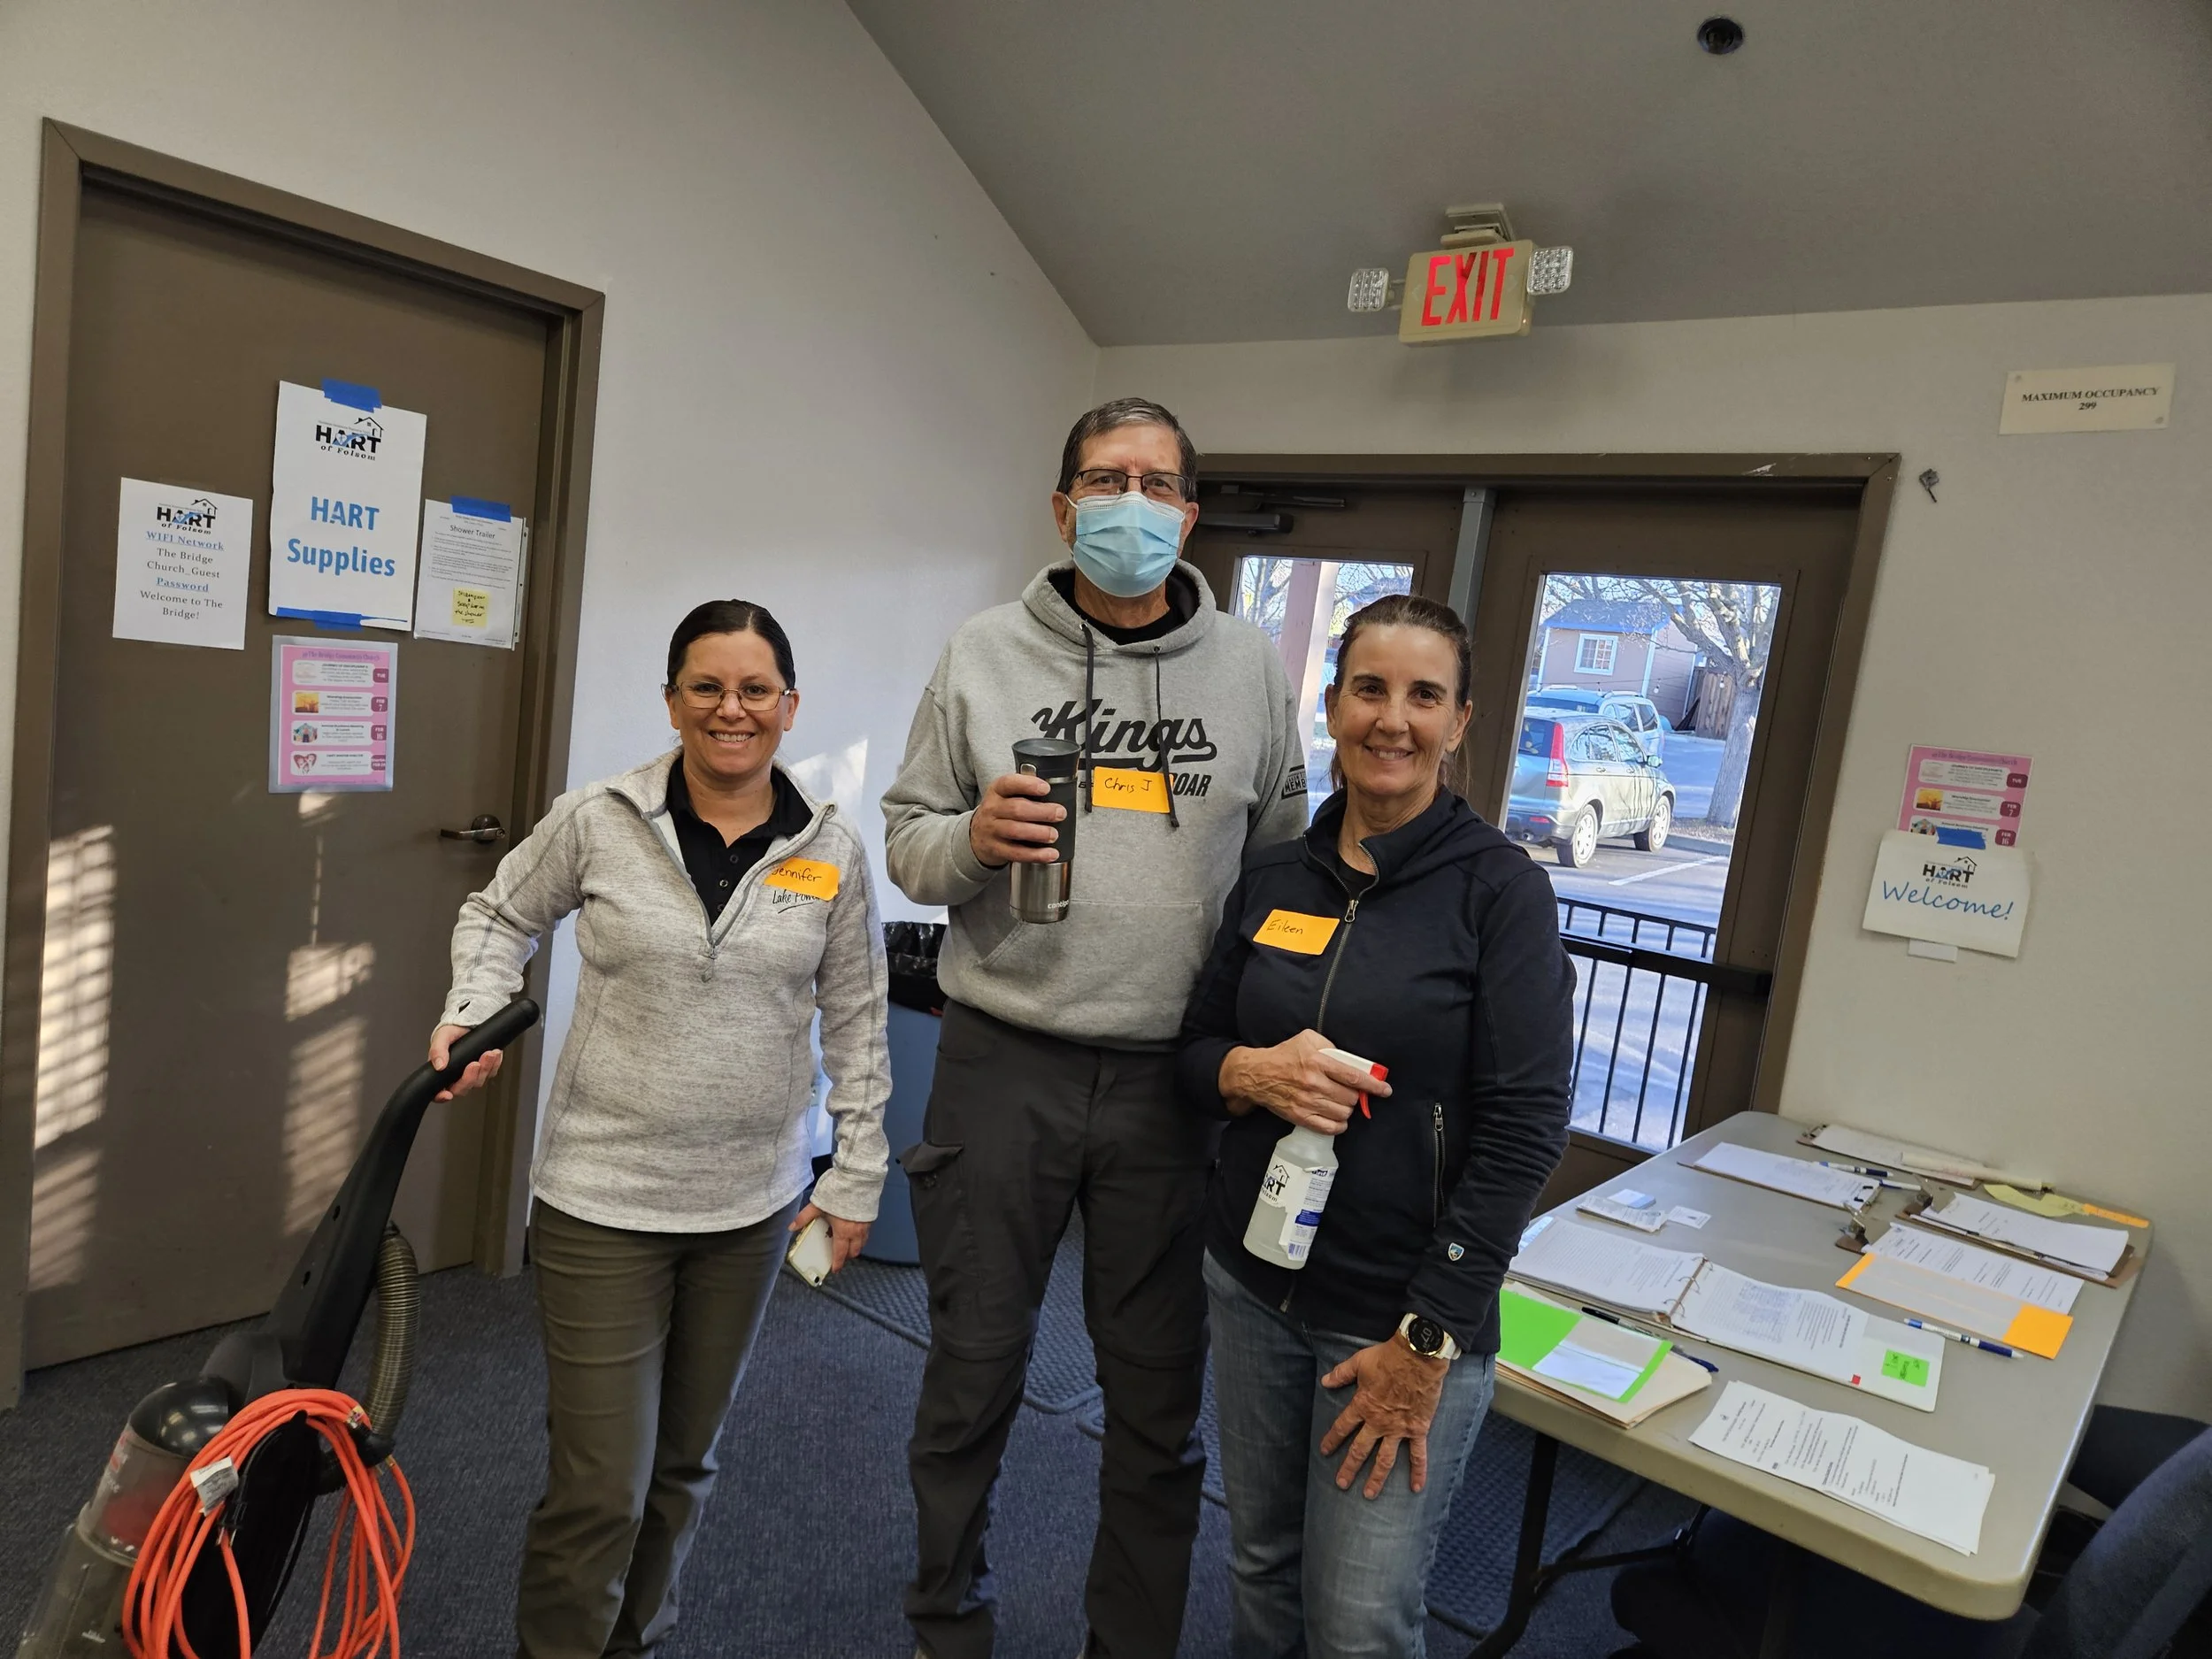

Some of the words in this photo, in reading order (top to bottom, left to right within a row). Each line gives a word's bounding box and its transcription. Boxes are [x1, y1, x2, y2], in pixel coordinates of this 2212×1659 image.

[1421, 247, 1515, 326] EXIT
[2022, 390, 2082, 403] MAXIMUM
[2085, 386, 2161, 398] OCCUPANCY
[2078, 402, 2097, 411] 299
[315, 424, 382, 454] HART
[337, 447, 376, 461] Folsom
[157, 506, 216, 528] HART
[311, 495, 380, 531] HART
[177, 524, 211, 534] Folsom
[449, 525, 474, 534] Shower
[476, 529, 495, 539] Trailer
[146, 531, 174, 543] WIFI
[178, 535, 225, 550] Network
[157, 548, 177, 558] The
[180, 551, 213, 565] Bridge
[287, 538, 396, 576] Supplies
[147, 560, 220, 579] Church_Guest
[156, 577, 209, 592] Password
[140, 590, 188, 604] Welcome
[204, 598, 223, 609] The
[162, 607, 200, 620] Bridge!
[1031, 699, 1217, 772] Kings
[1104, 777, 1134, 793] Chris
[1172, 772, 1212, 797] OAR
[771, 867, 822, 882] Jennifer
[1923, 864, 1974, 883] HART
[1938, 879, 1968, 888] Folsom
[772, 888, 792, 904] Lake
[1883, 880, 2014, 920] Welcome!
[1266, 919, 1303, 934] Eileen
